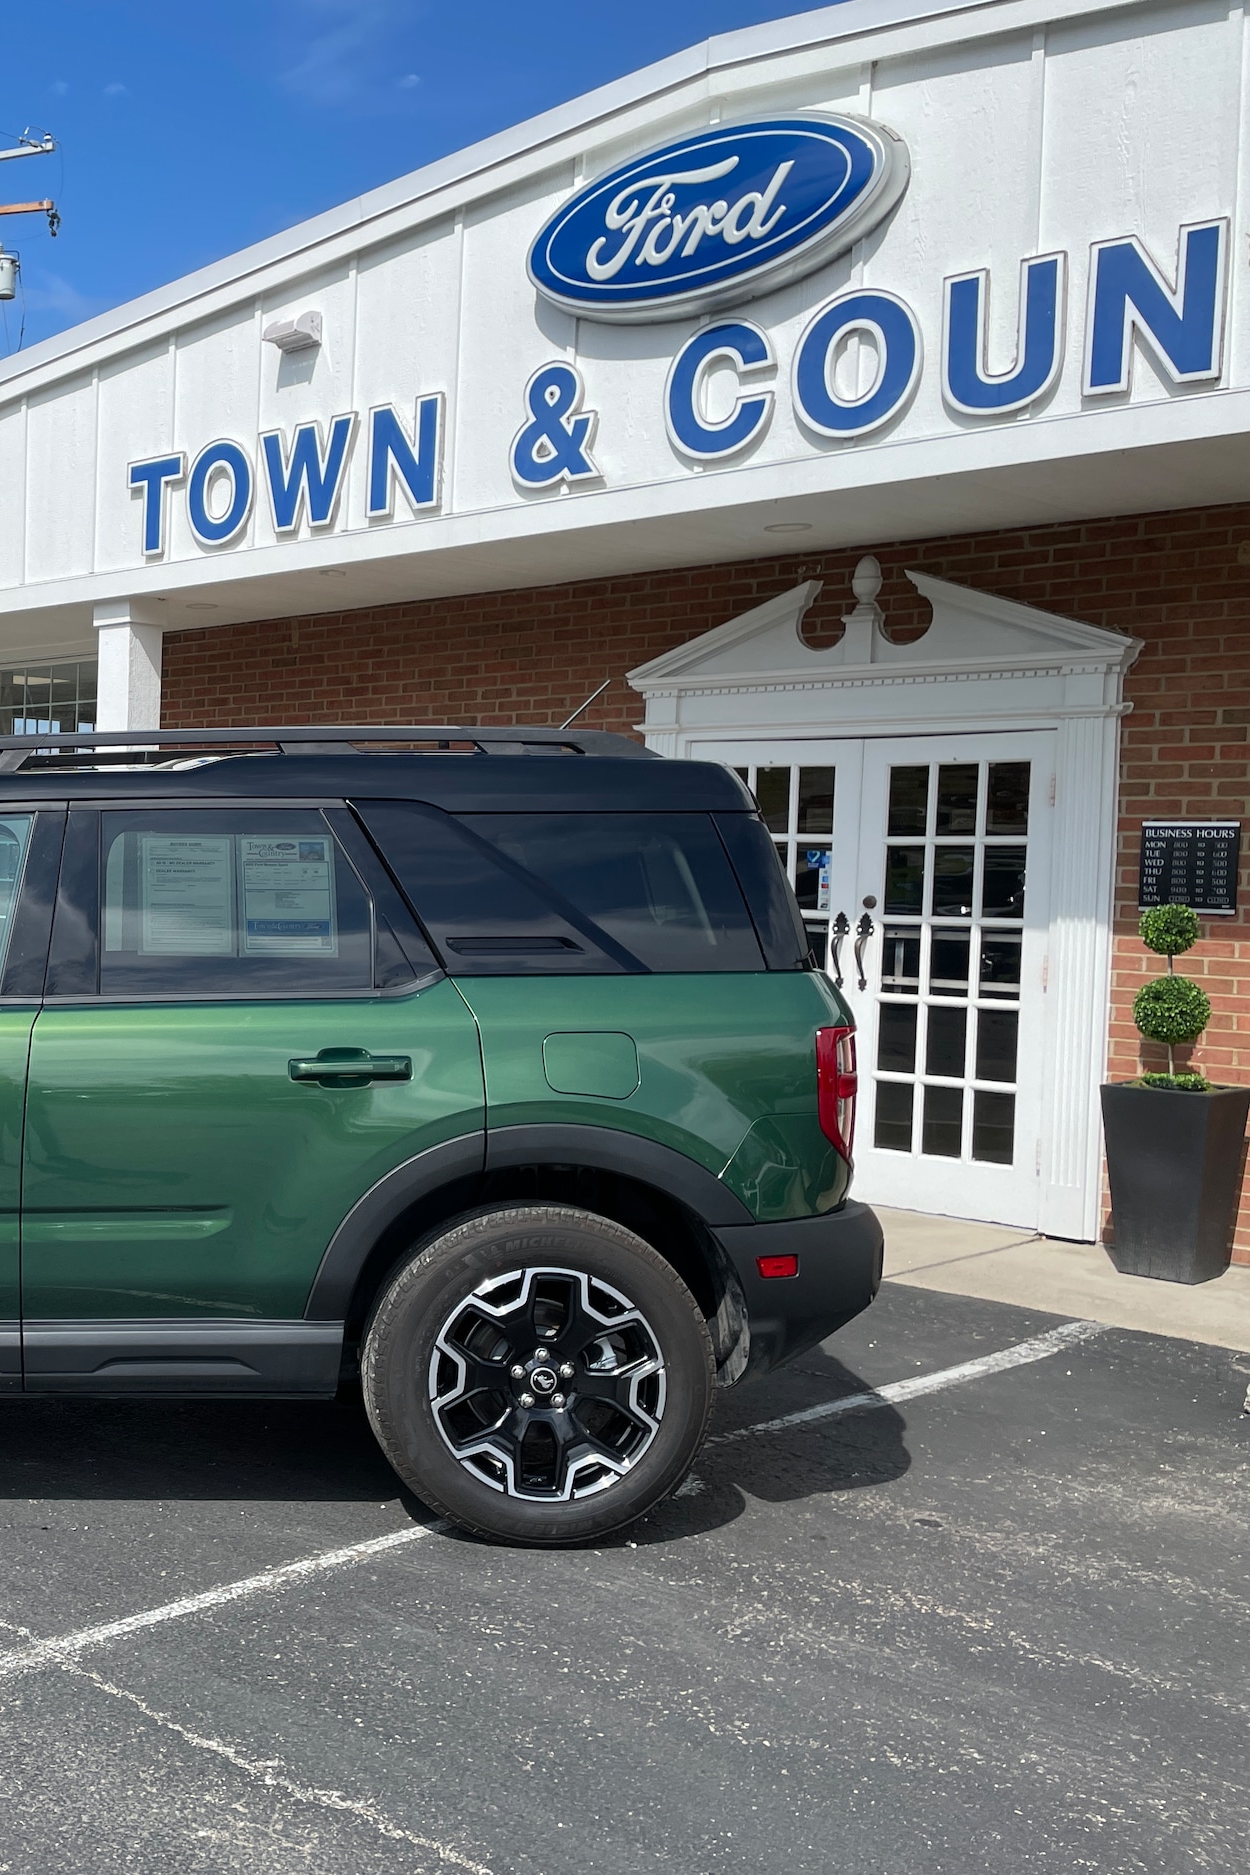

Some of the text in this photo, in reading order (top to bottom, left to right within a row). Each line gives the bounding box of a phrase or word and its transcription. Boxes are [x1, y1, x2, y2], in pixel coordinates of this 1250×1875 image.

[586, 155, 794, 281] Ford
[127, 216, 1230, 556] TOWN & COUN
[1145, 829, 1235, 838] BUSINESS HOURS
[246, 841, 275, 852] Town &
[258, 849, 285, 858] Country
